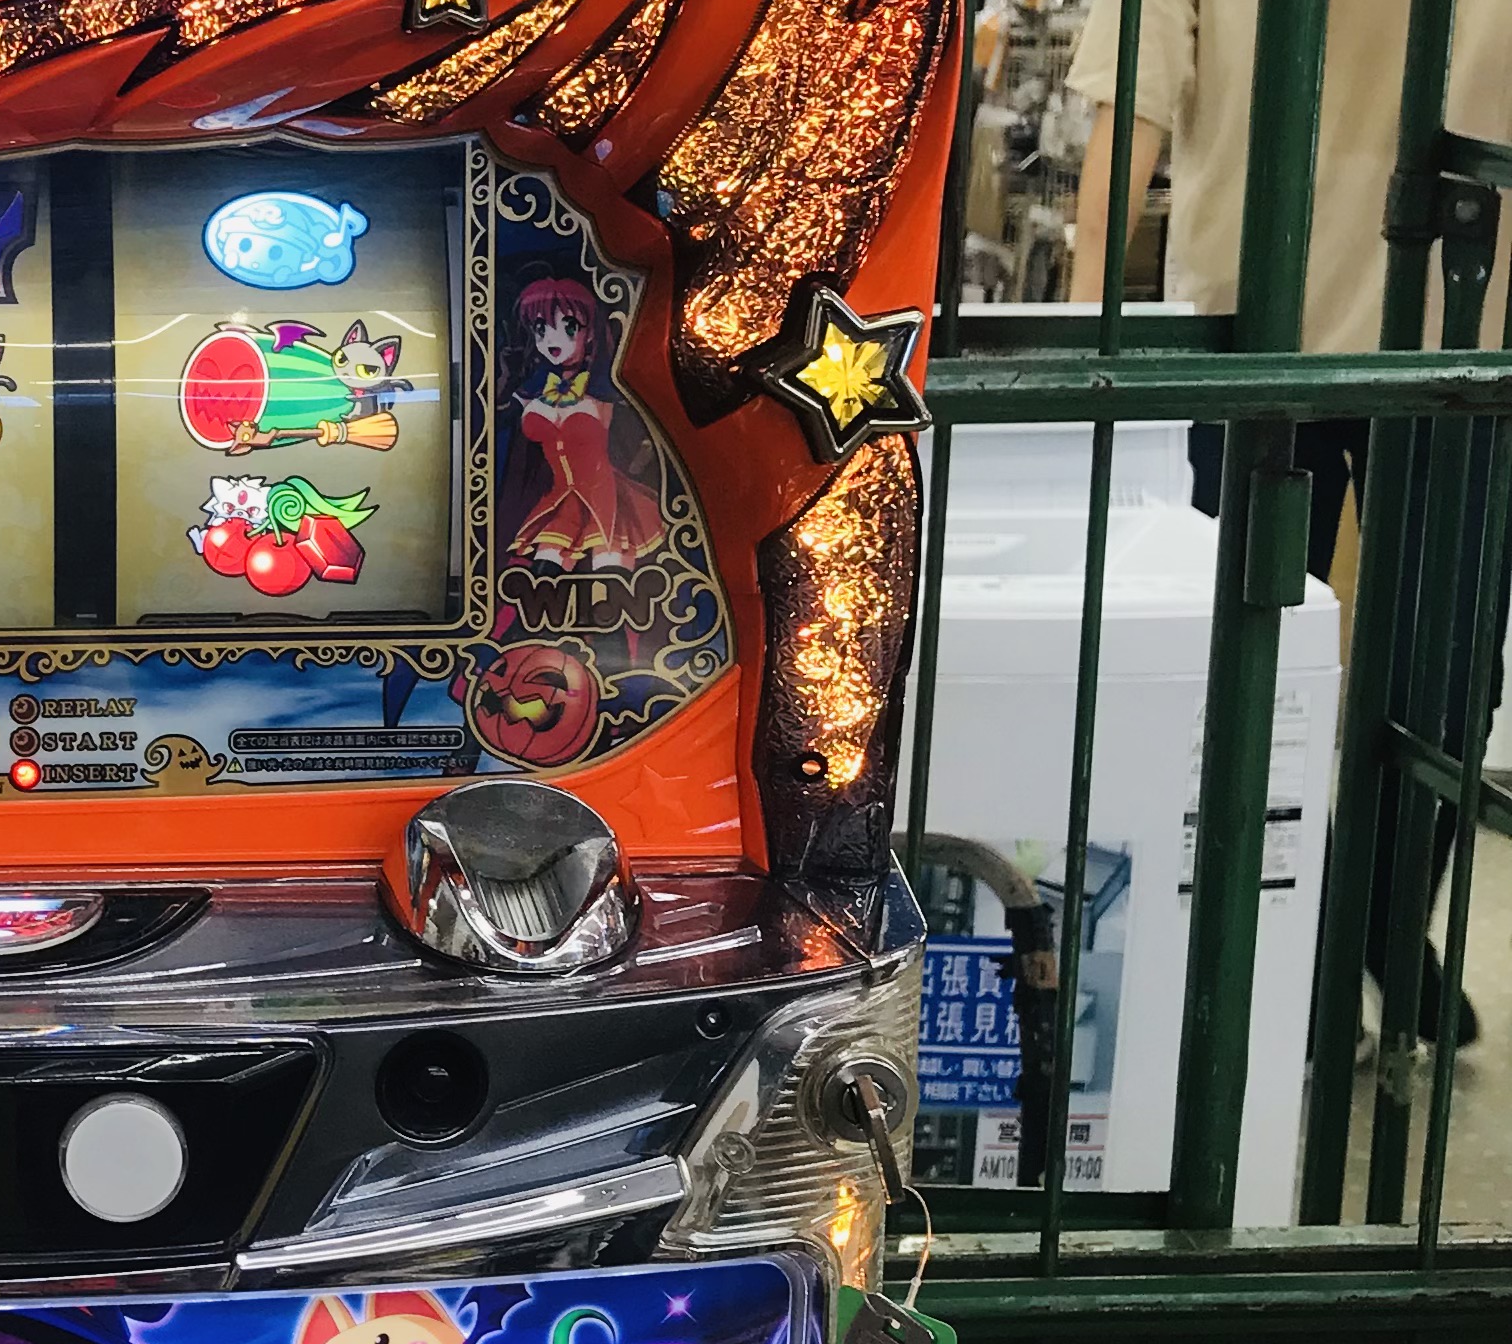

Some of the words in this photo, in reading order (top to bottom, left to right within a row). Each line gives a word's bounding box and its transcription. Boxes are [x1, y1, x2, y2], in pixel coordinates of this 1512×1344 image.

[40, 698, 138, 719] REPLAY
[40, 731, 138, 752] START
[40, 764, 138, 785] INSERT
